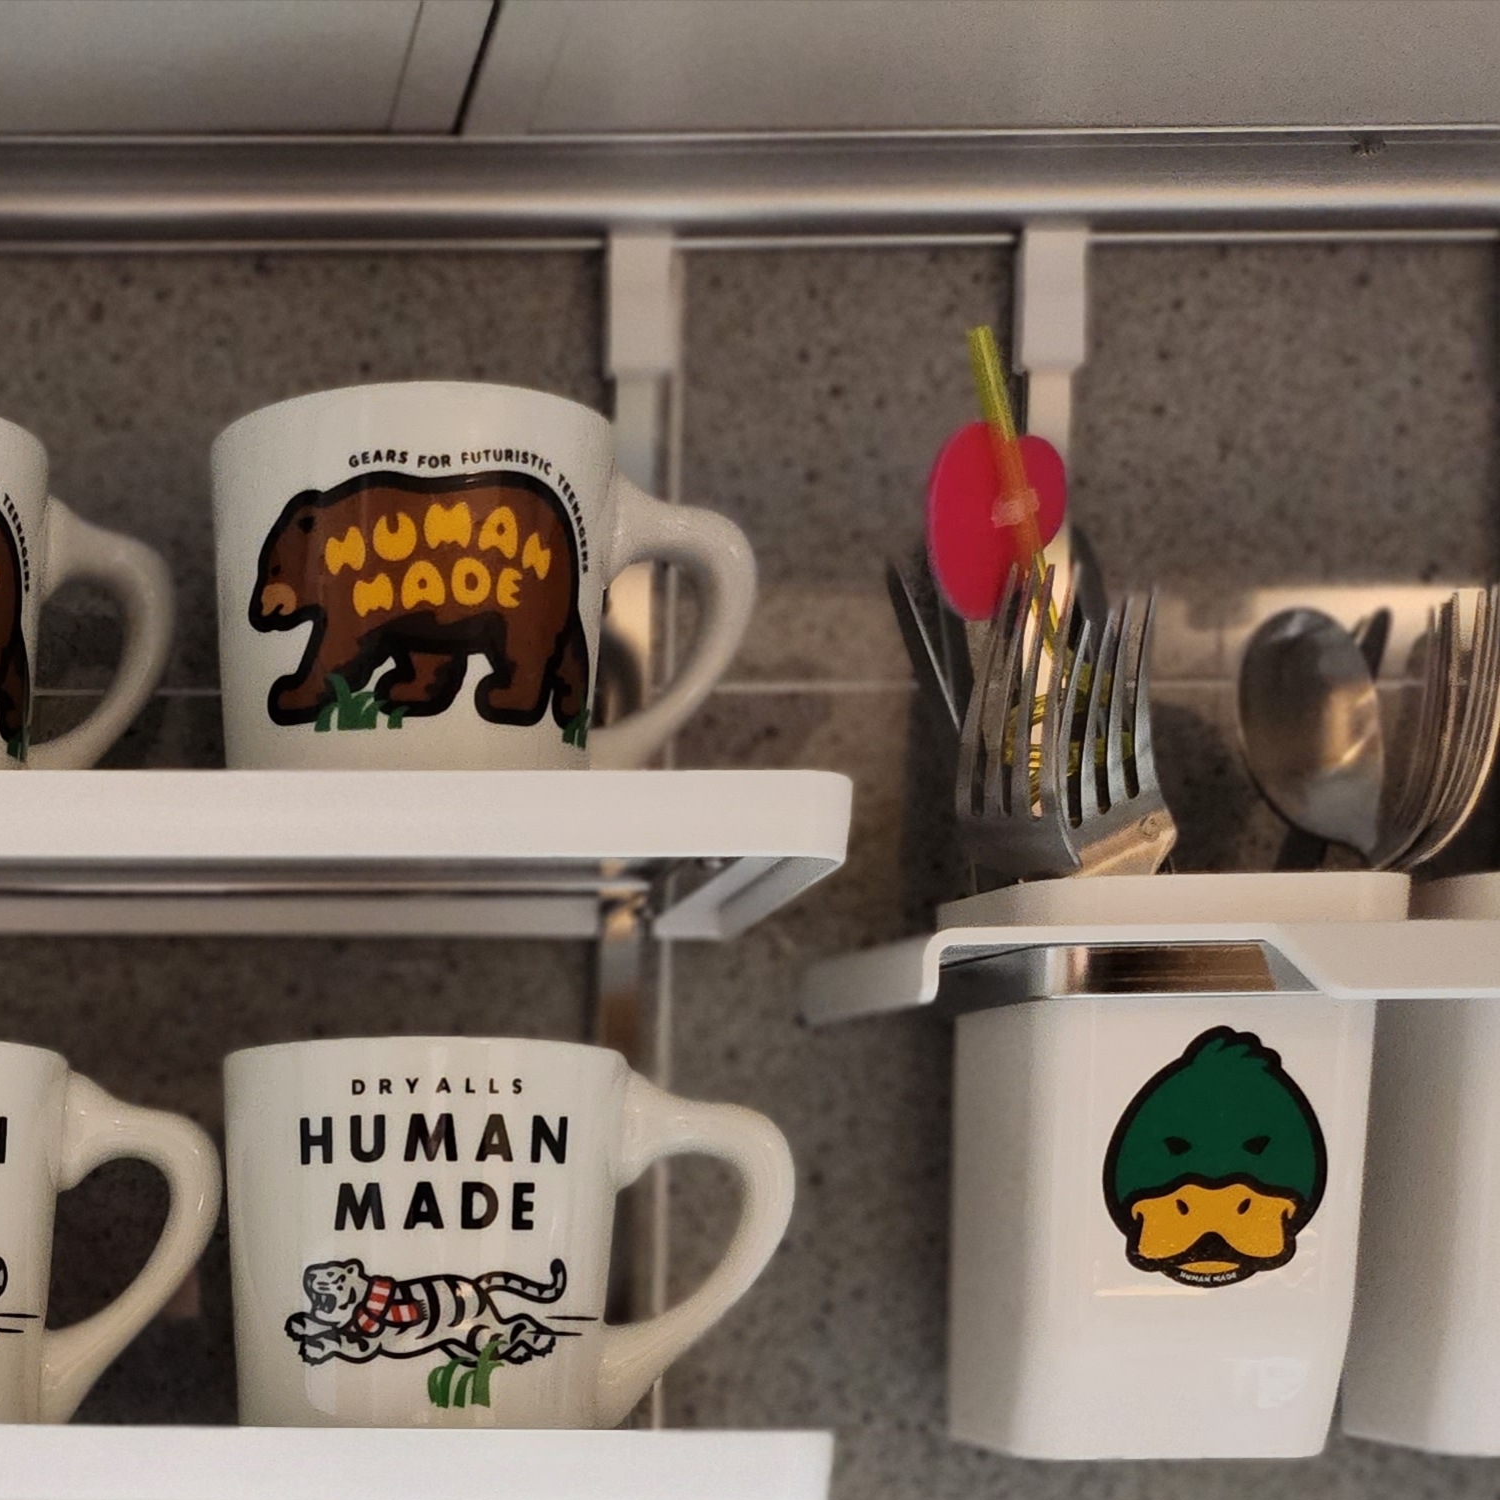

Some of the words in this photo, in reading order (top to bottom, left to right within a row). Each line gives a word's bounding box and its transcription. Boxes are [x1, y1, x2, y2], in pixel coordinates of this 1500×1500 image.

[348, 449, 409, 468] GEARS
[417, 453, 451, 469] FOR
[461, 448, 552, 476] FUTURISTIC
[324, 501, 551, 581] HUMAN
[353, 557, 522, 618] MADE
[299, 1113, 569, 1165] HUMAN
[334, 1182, 535, 1231] MADE
[1180, 1271, 1210, 1282] HUMAN
[1213, 1271, 1237, 1282] MADE
